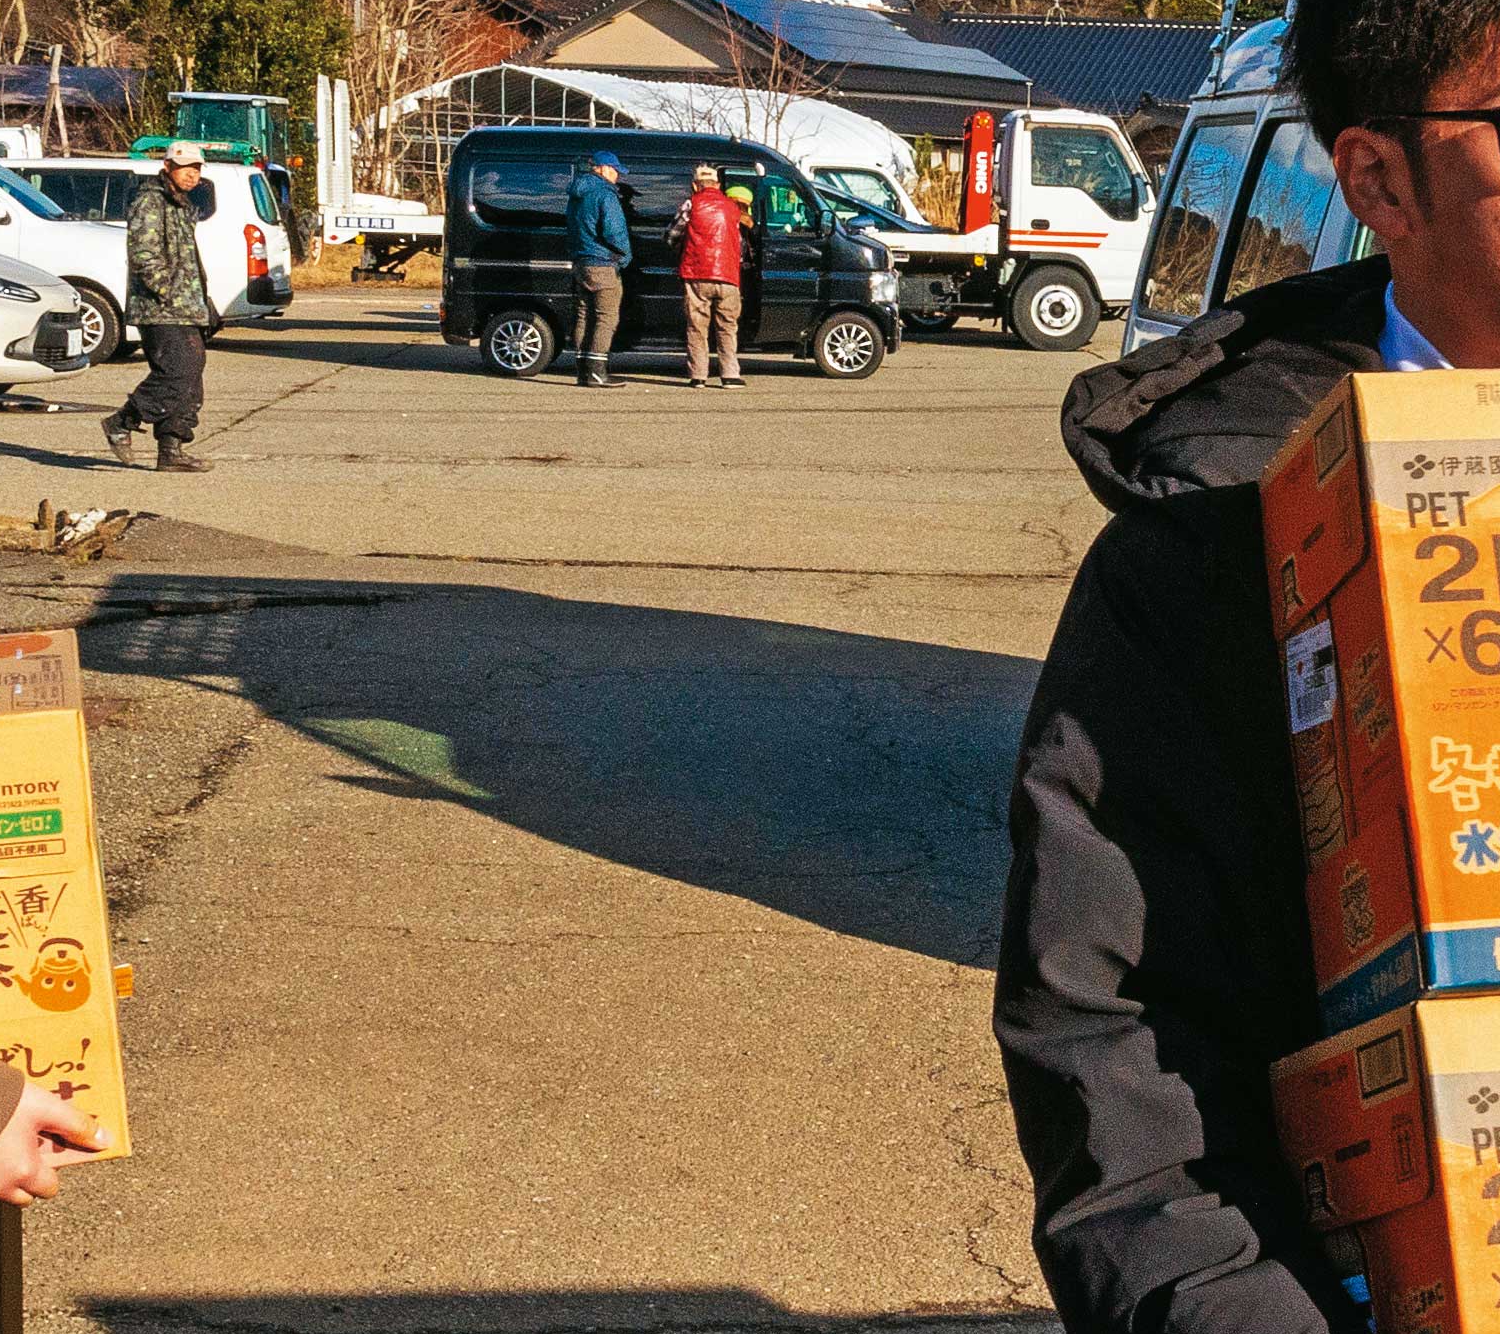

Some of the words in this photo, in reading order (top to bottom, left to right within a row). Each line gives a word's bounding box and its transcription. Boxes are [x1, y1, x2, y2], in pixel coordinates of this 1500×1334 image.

[975, 151, 988, 195] UNIC
[1406, 490, 1470, 528] PET
[15, 886, 49, 915] 香
